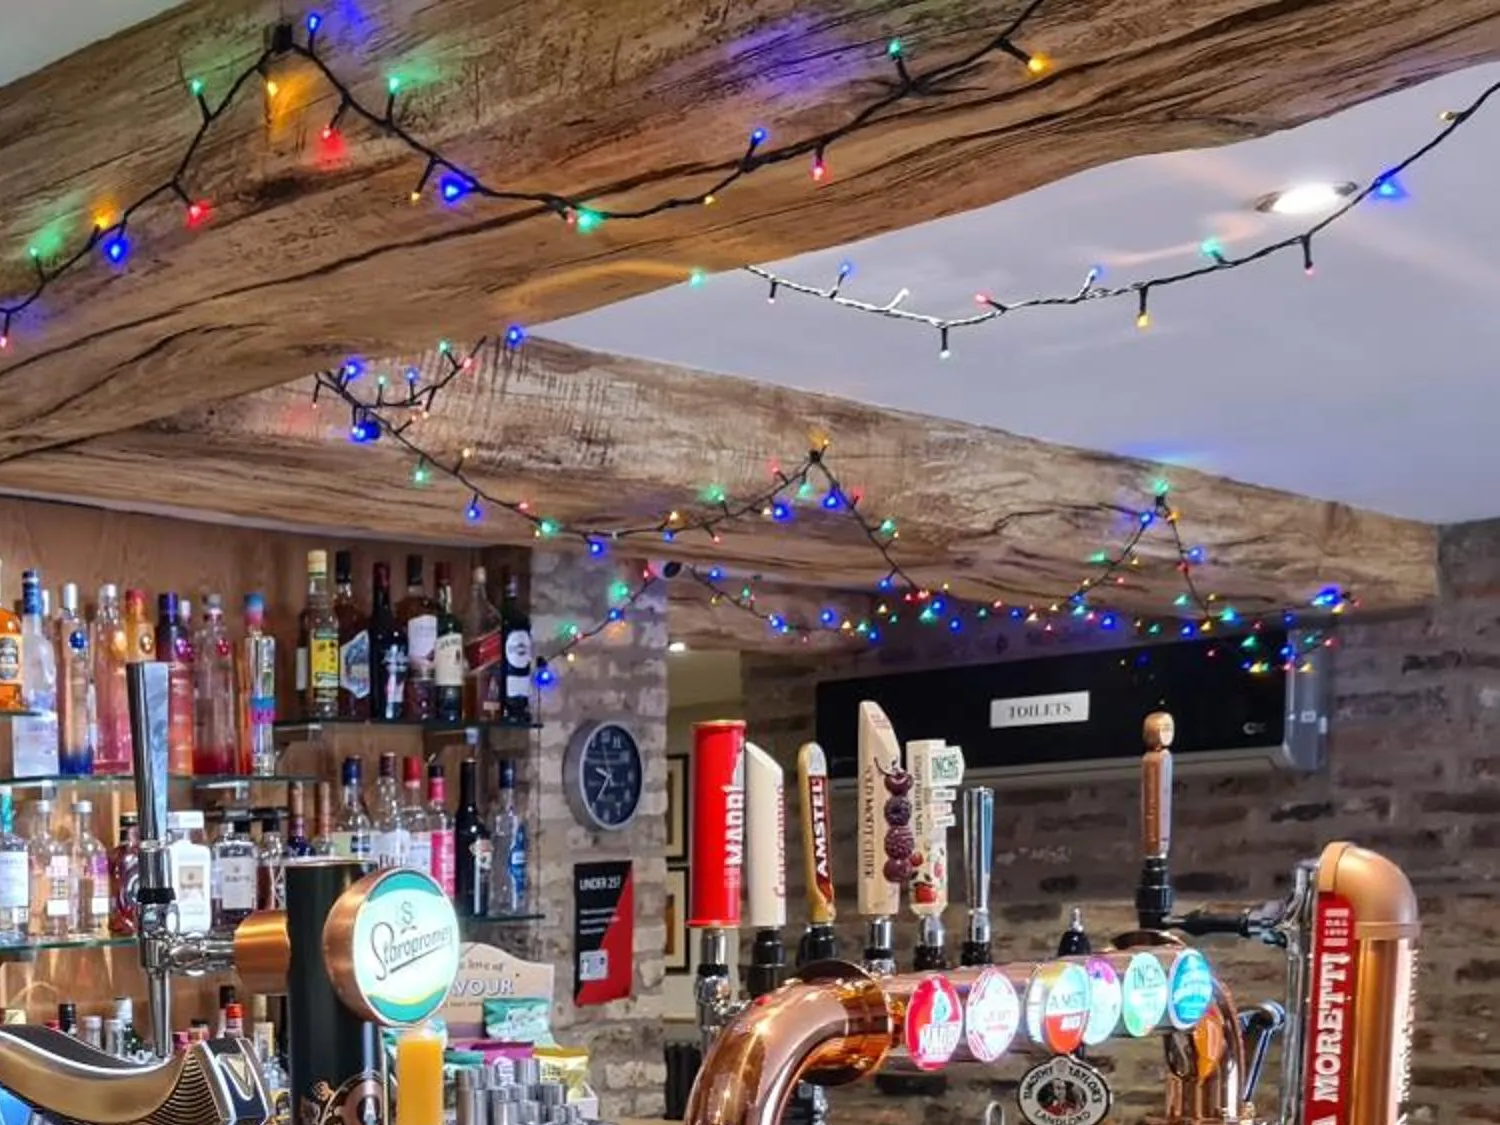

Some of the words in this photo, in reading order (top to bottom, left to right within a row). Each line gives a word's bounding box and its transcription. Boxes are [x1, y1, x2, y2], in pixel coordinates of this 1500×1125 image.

[1008, 702, 1072, 718] TOILETS
[809, 778, 828, 878] AMSTEL
[579, 877, 607, 891] UNDER
[1314, 951, 1348, 1103] MORETTI
